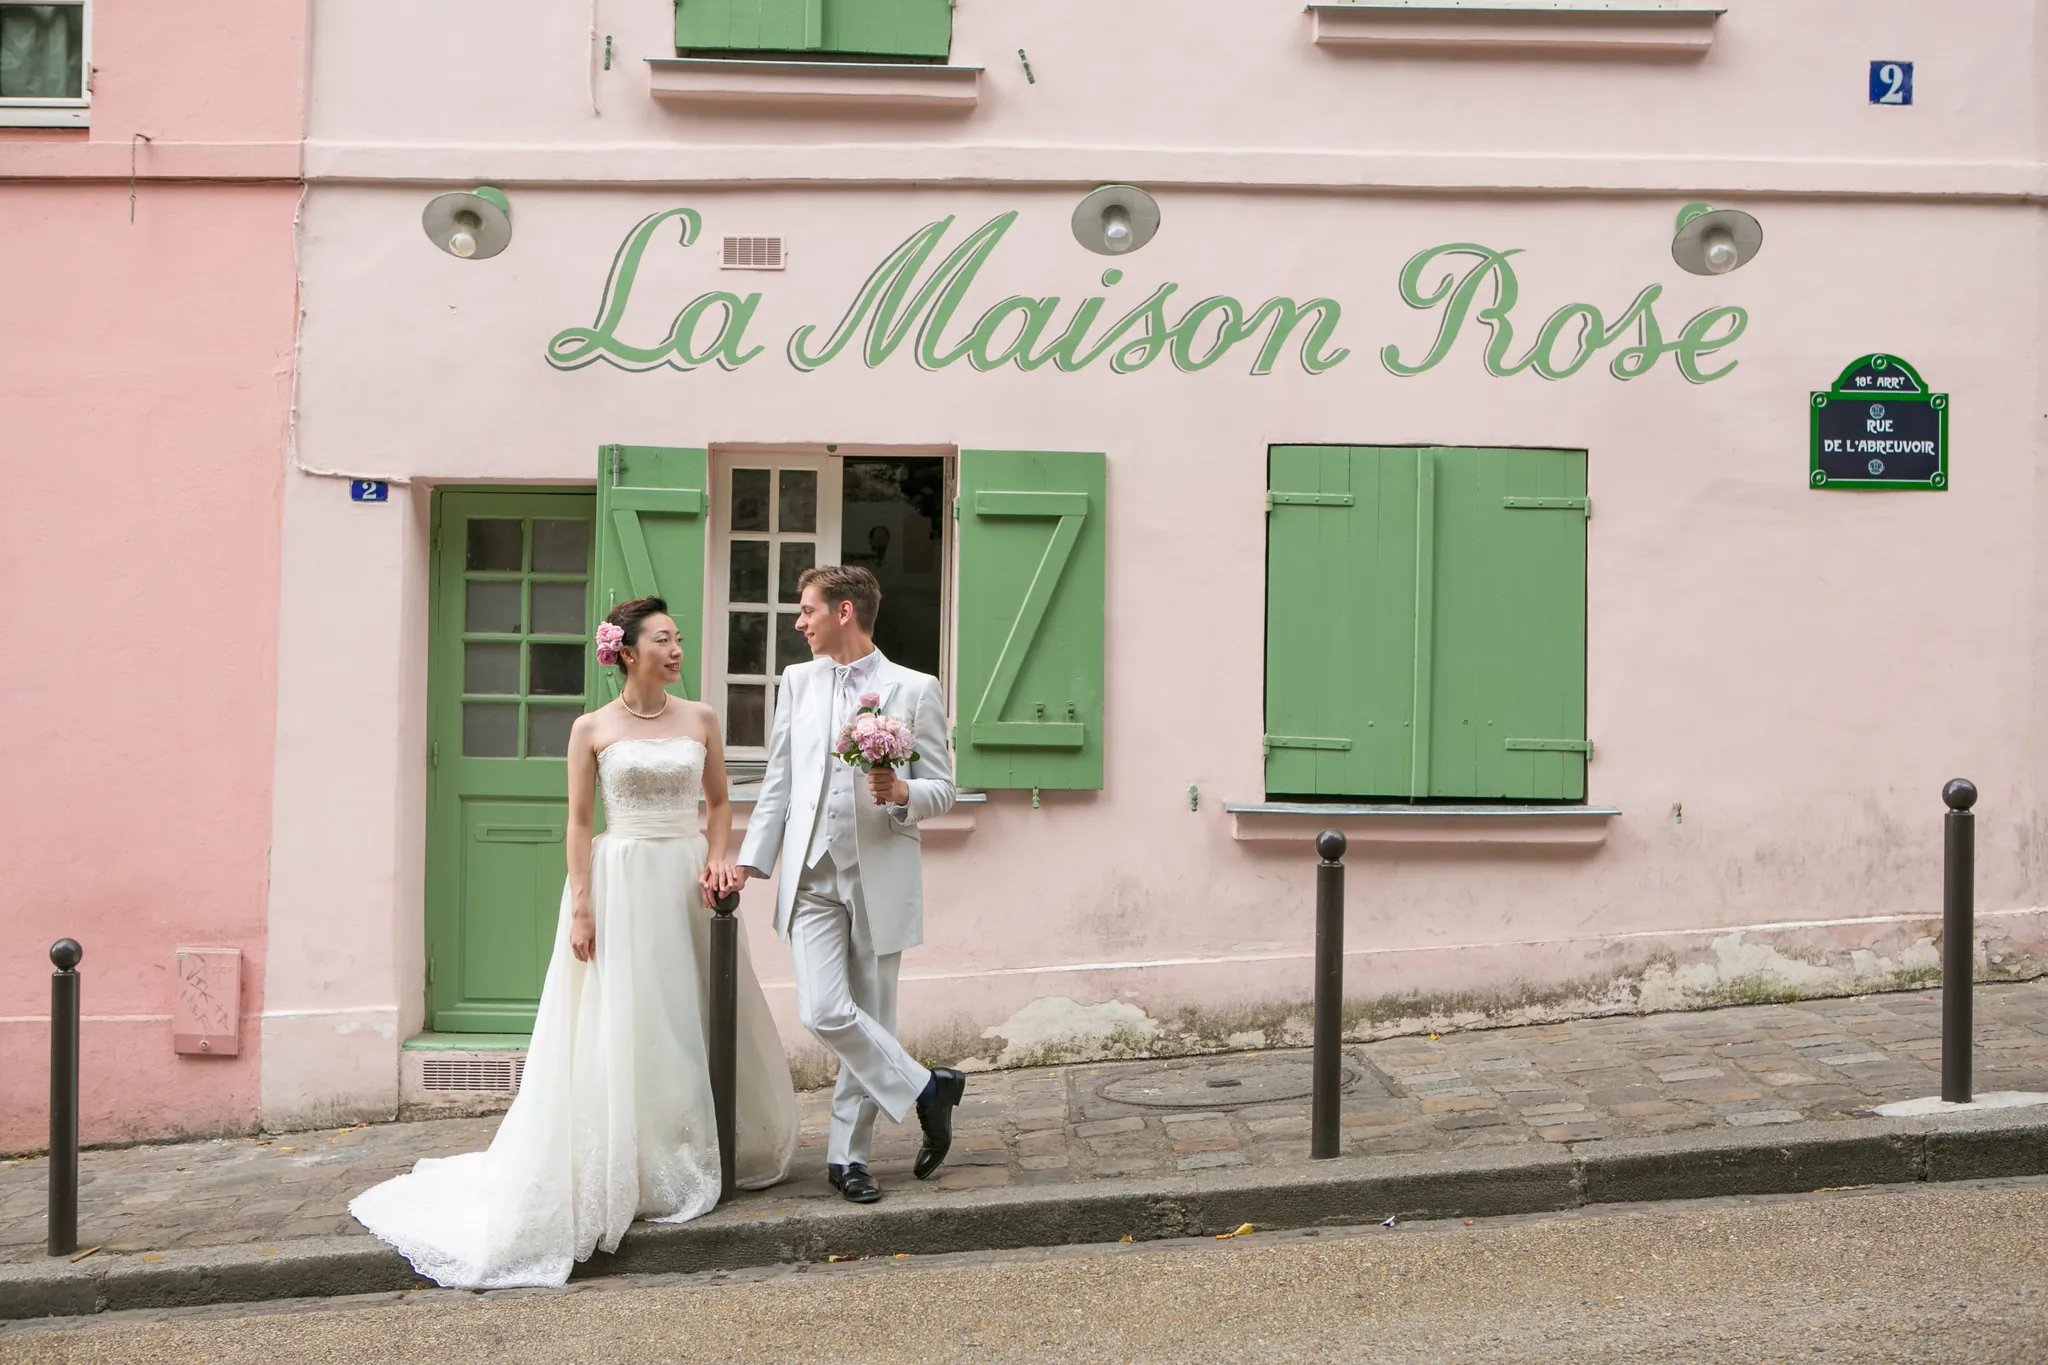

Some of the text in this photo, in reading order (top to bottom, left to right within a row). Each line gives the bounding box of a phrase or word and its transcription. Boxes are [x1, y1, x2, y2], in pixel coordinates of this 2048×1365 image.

[1879, 63, 1904, 104] 2
[544, 207, 1749, 385] La Maison Rose
[1866, 419, 1894, 434] RUE
[1823, 439, 1936, 456] DE L'ABREUVOIR
[362, 481, 377, 500] 2
